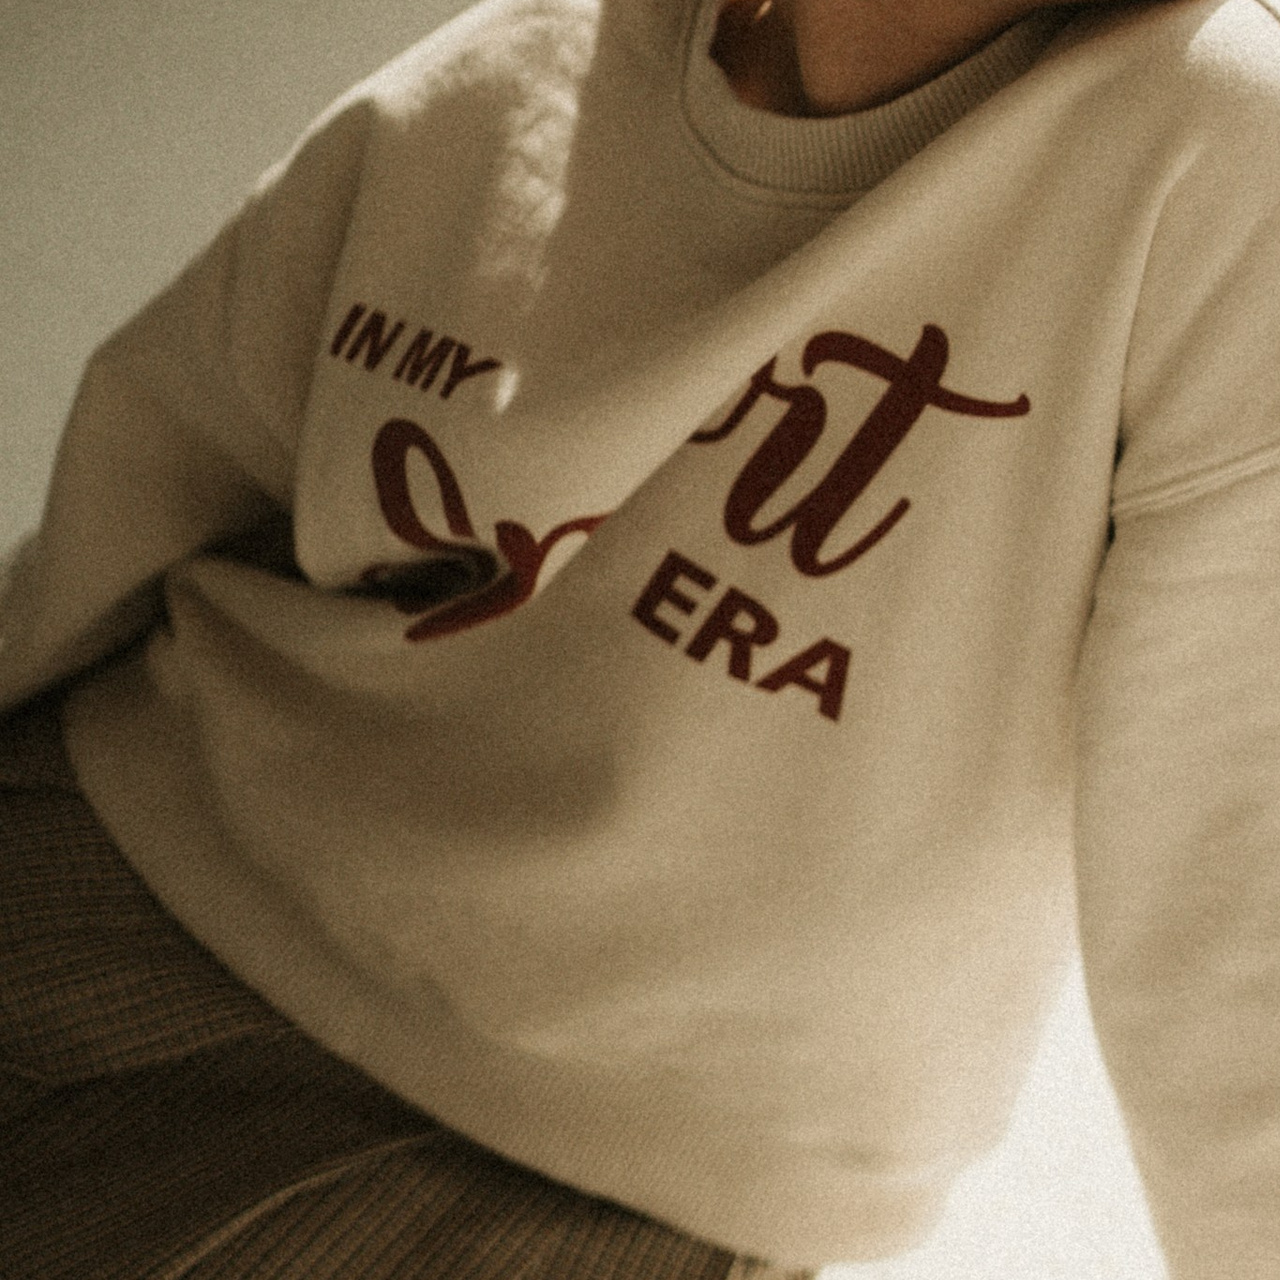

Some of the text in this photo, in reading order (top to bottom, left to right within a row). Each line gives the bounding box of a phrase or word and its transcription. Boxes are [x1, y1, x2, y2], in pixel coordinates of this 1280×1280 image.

[330, 303, 503, 400] IN MY
[631, 548, 852, 723] ERA
